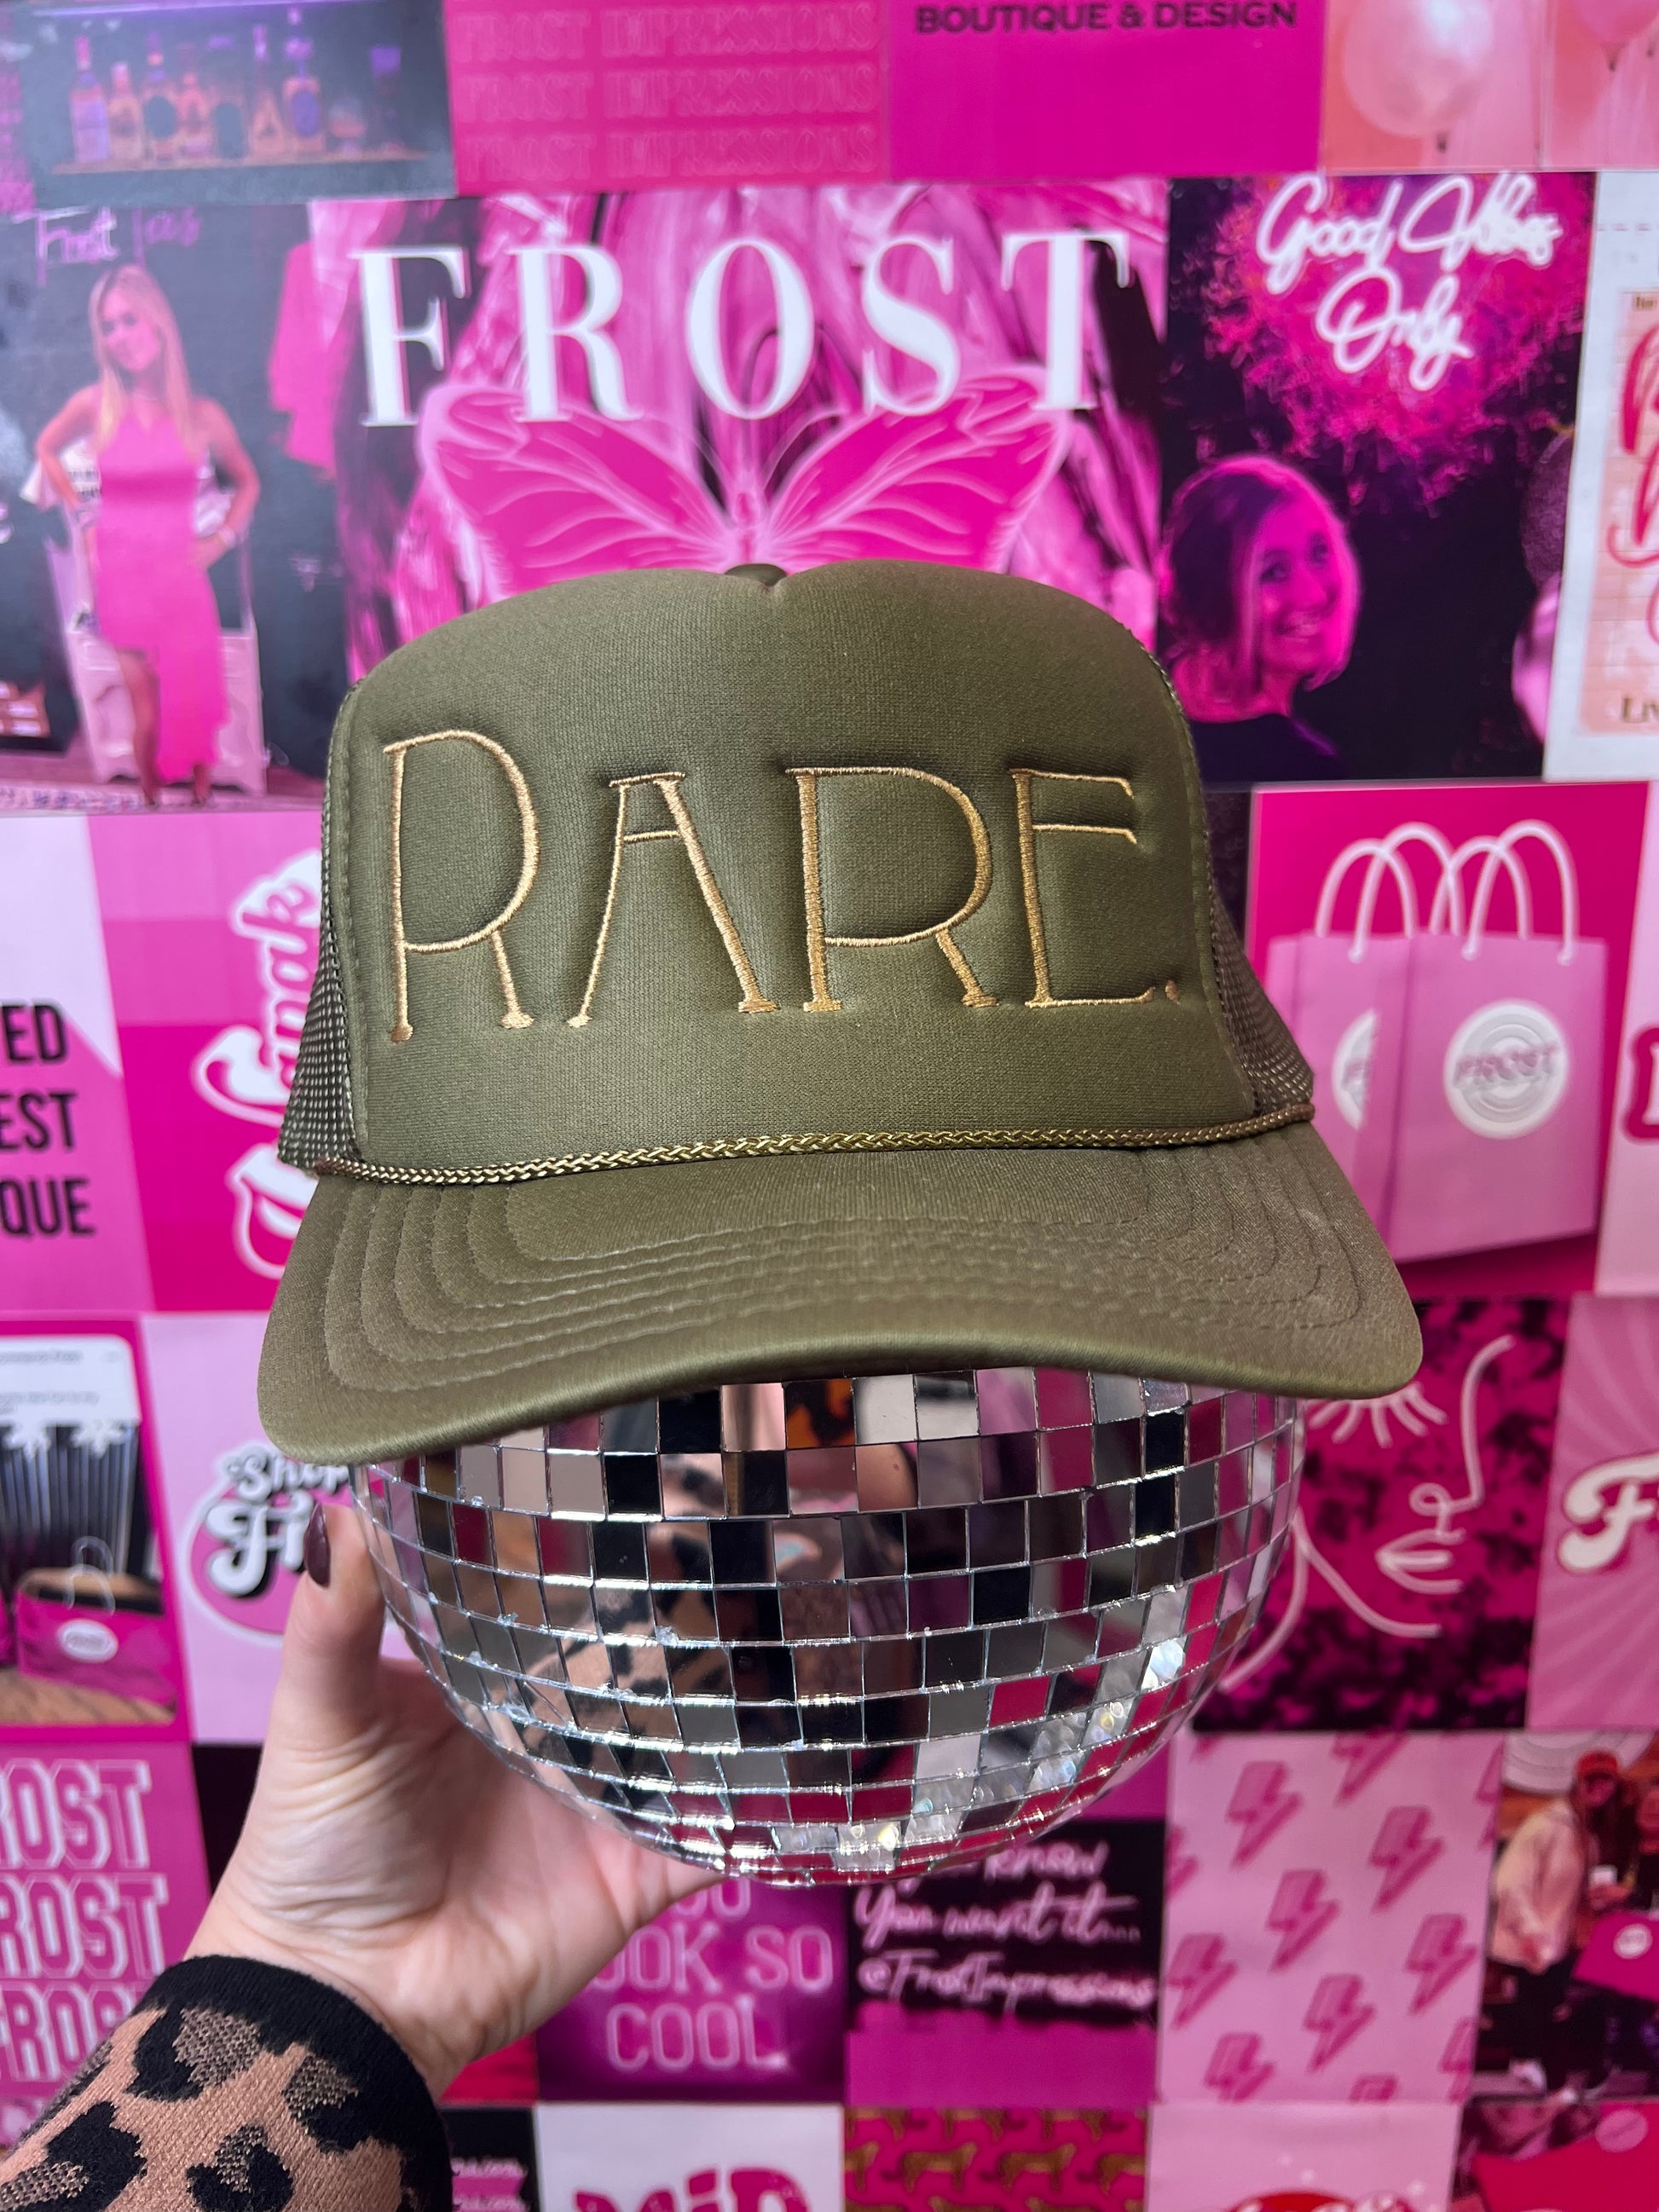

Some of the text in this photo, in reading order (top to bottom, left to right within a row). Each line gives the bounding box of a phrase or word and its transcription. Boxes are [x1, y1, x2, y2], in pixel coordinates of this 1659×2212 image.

[916, 2, 1298, 34] BOUTIQUE & DESIGN
[1256, 173, 1403, 294] Good
[348, 231, 1131, 428] FROST
[1316, 266, 1475, 392] Only
[0, 1759, 152, 1869] OST
[745, 1924, 834, 1993] SO
[855, 1884, 937, 1951] You
[606, 1996, 789, 2073] COOL
